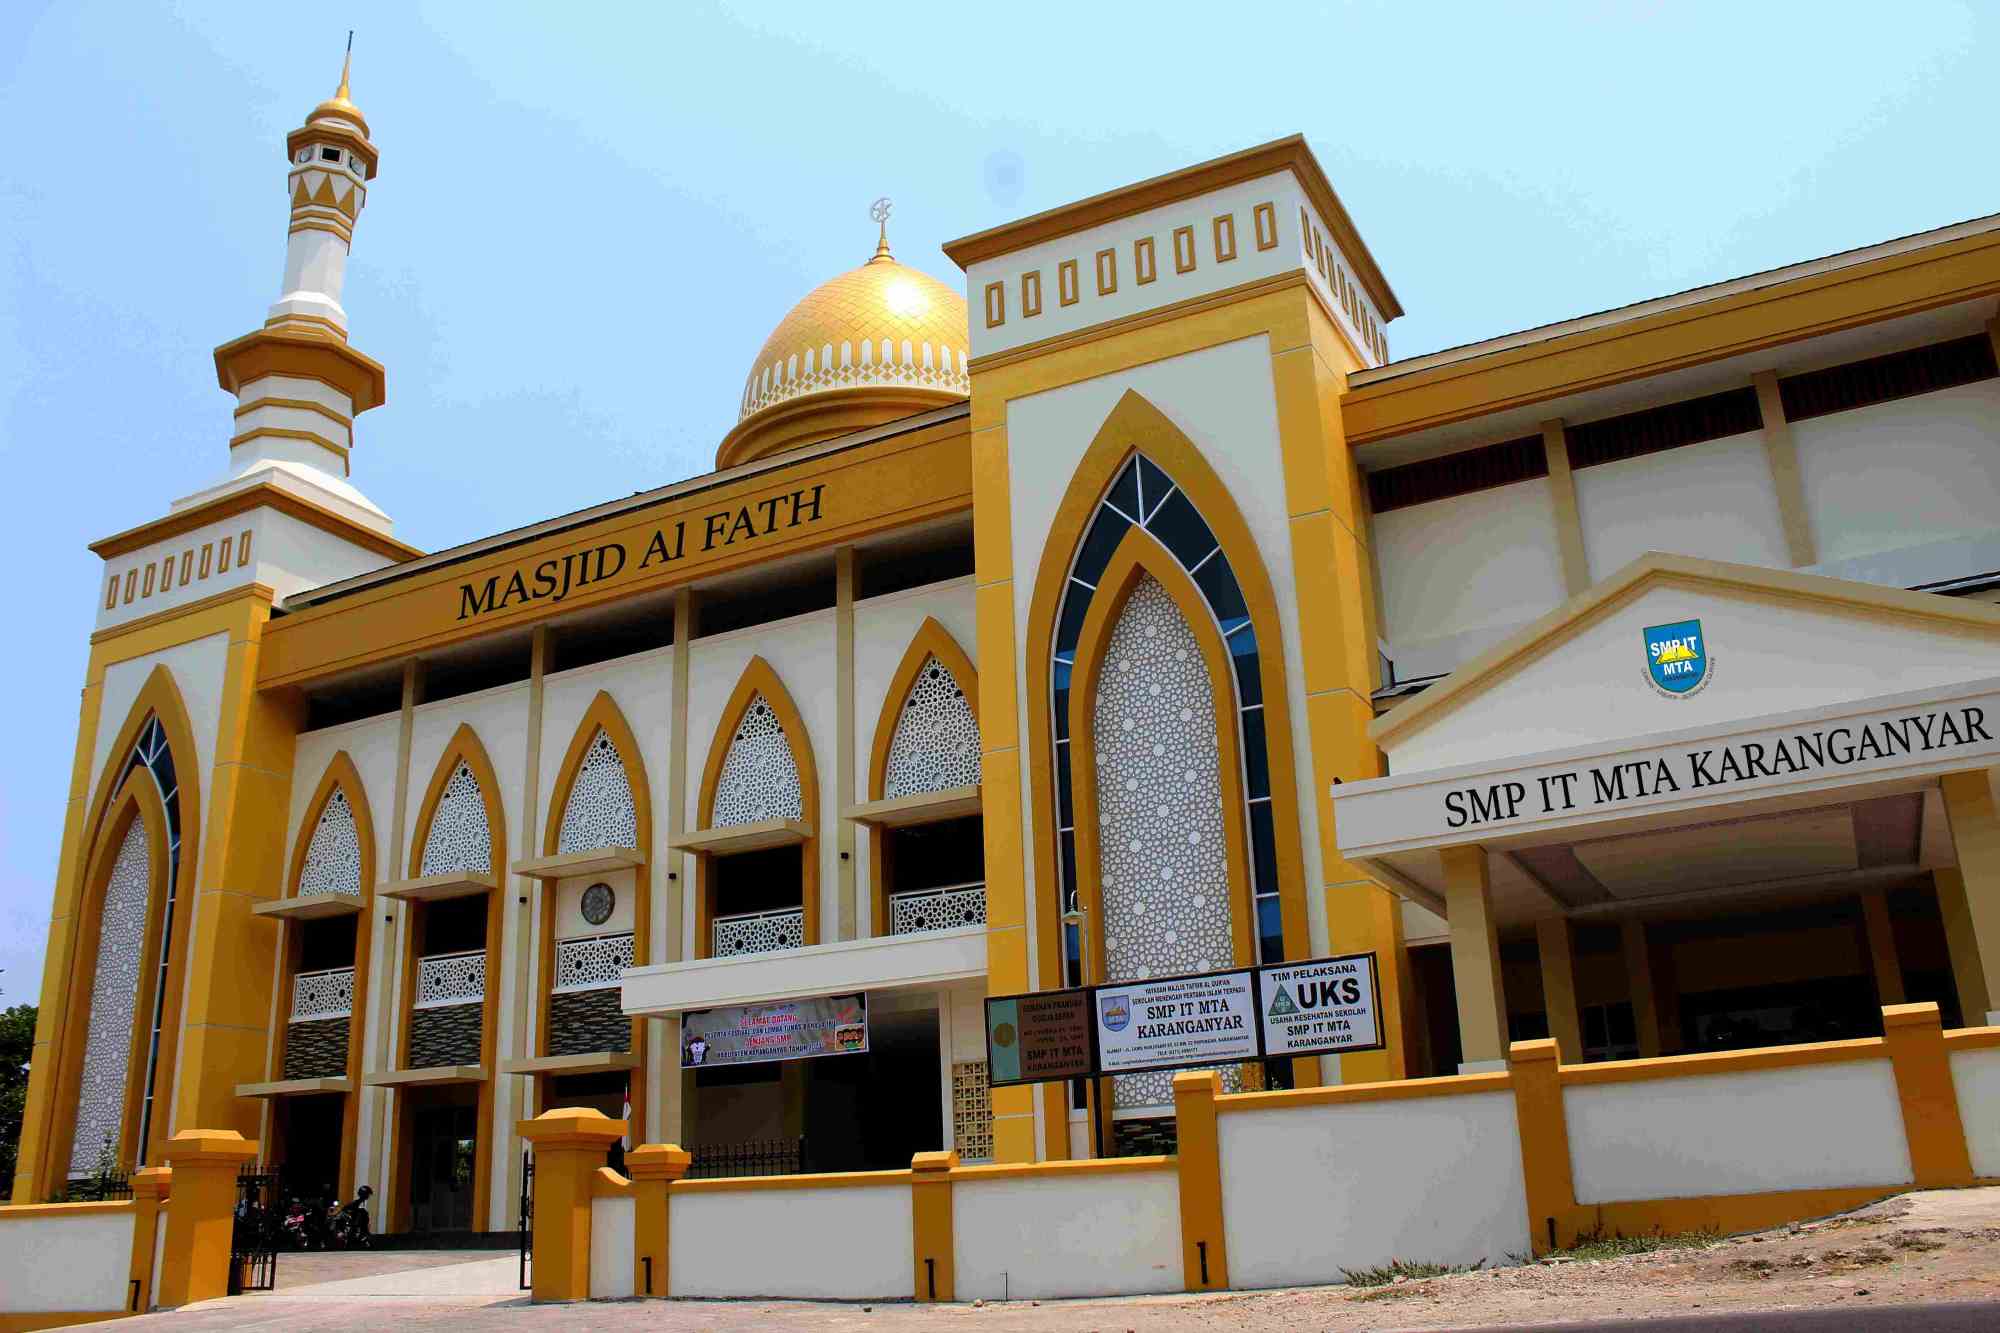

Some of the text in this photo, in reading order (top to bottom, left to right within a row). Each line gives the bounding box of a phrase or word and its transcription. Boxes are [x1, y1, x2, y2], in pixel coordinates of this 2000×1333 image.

[458, 544, 625, 621] MASJID
[701, 485, 825, 552] FATH
[1650, 636, 1697, 657] SMP IT
[1663, 660, 1694, 676] MTA
[1446, 706, 1994, 828] SMP IT MTA KARANGANYAR
[1271, 964, 1357, 982] TIM PELAKSANA
[1297, 978, 1361, 1009] UKS
[1147, 998, 1230, 1020] SMP IT MTA
[1270, 1007, 1367, 1024] USAHA KESEHATAN SEKOLAH
[1136, 1015, 1244, 1039] KARANGANYAR
[1287, 1019, 1351, 1036] SMP IT MTA
[1287, 1034, 1353, 1048] KARANGANYAR
[1027, 1045, 1084, 1060] SMP IT MTA
